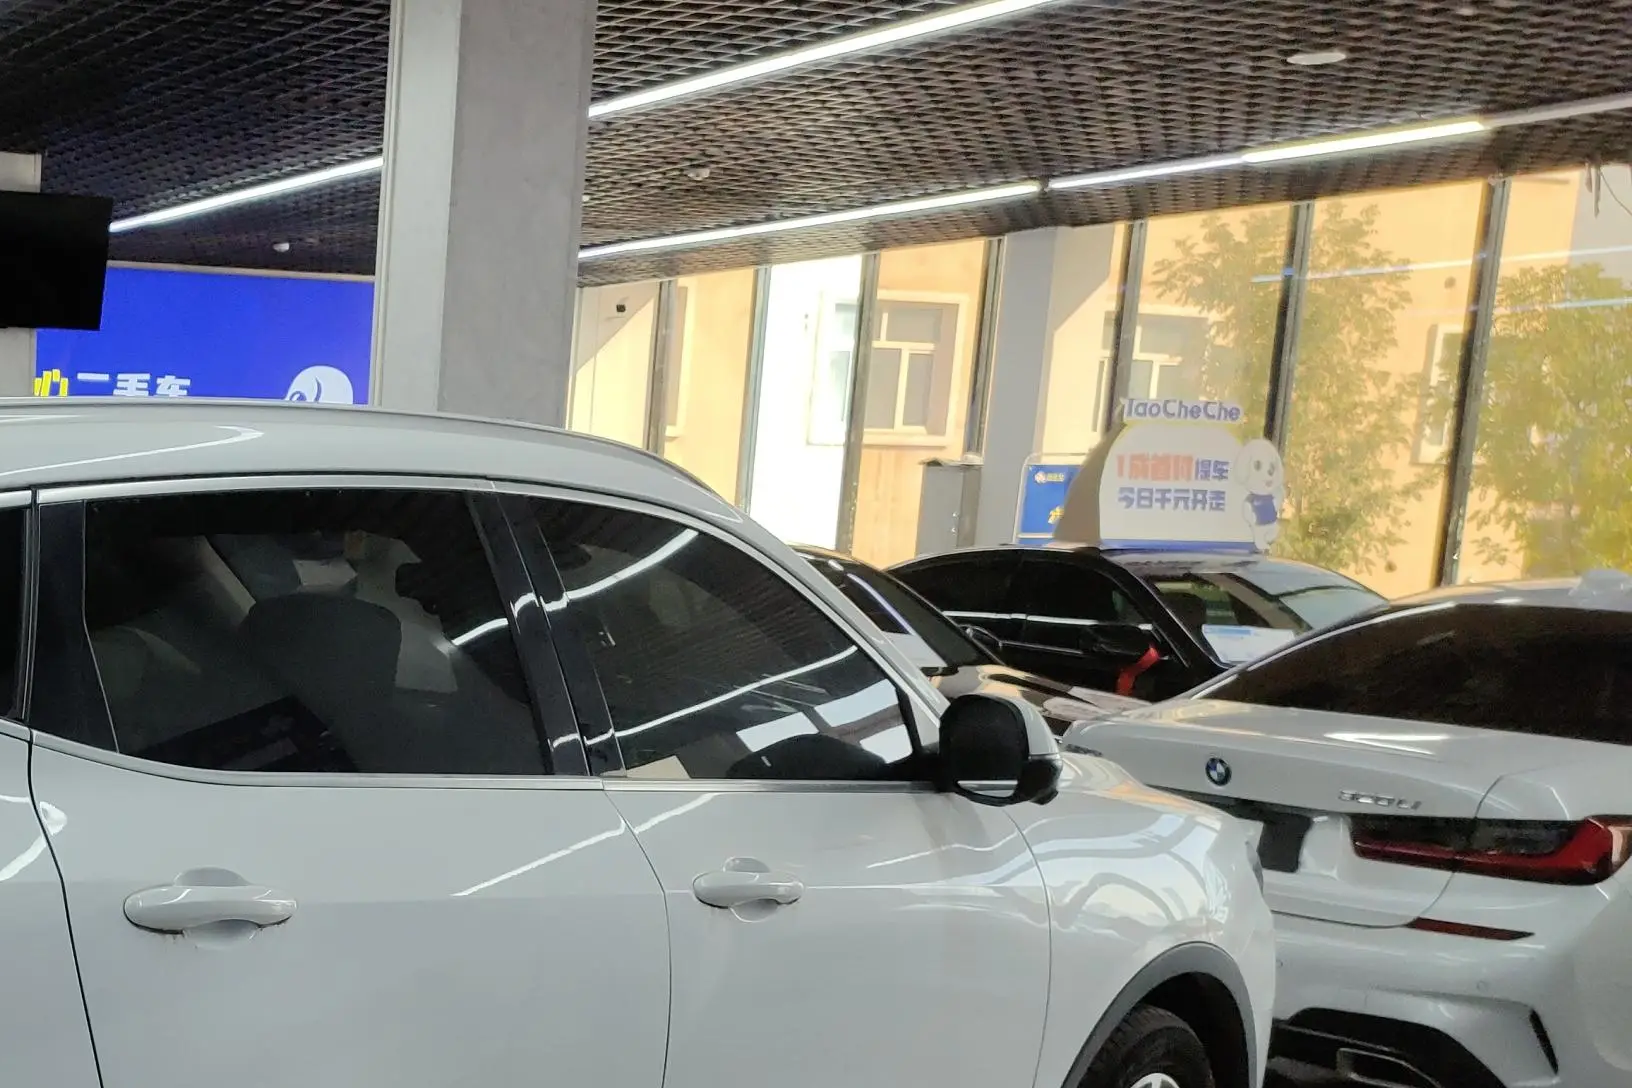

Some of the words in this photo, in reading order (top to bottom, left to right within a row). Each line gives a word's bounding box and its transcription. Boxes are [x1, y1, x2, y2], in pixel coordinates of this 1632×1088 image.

[1118, 486, 1226, 512] 今日千元开走
